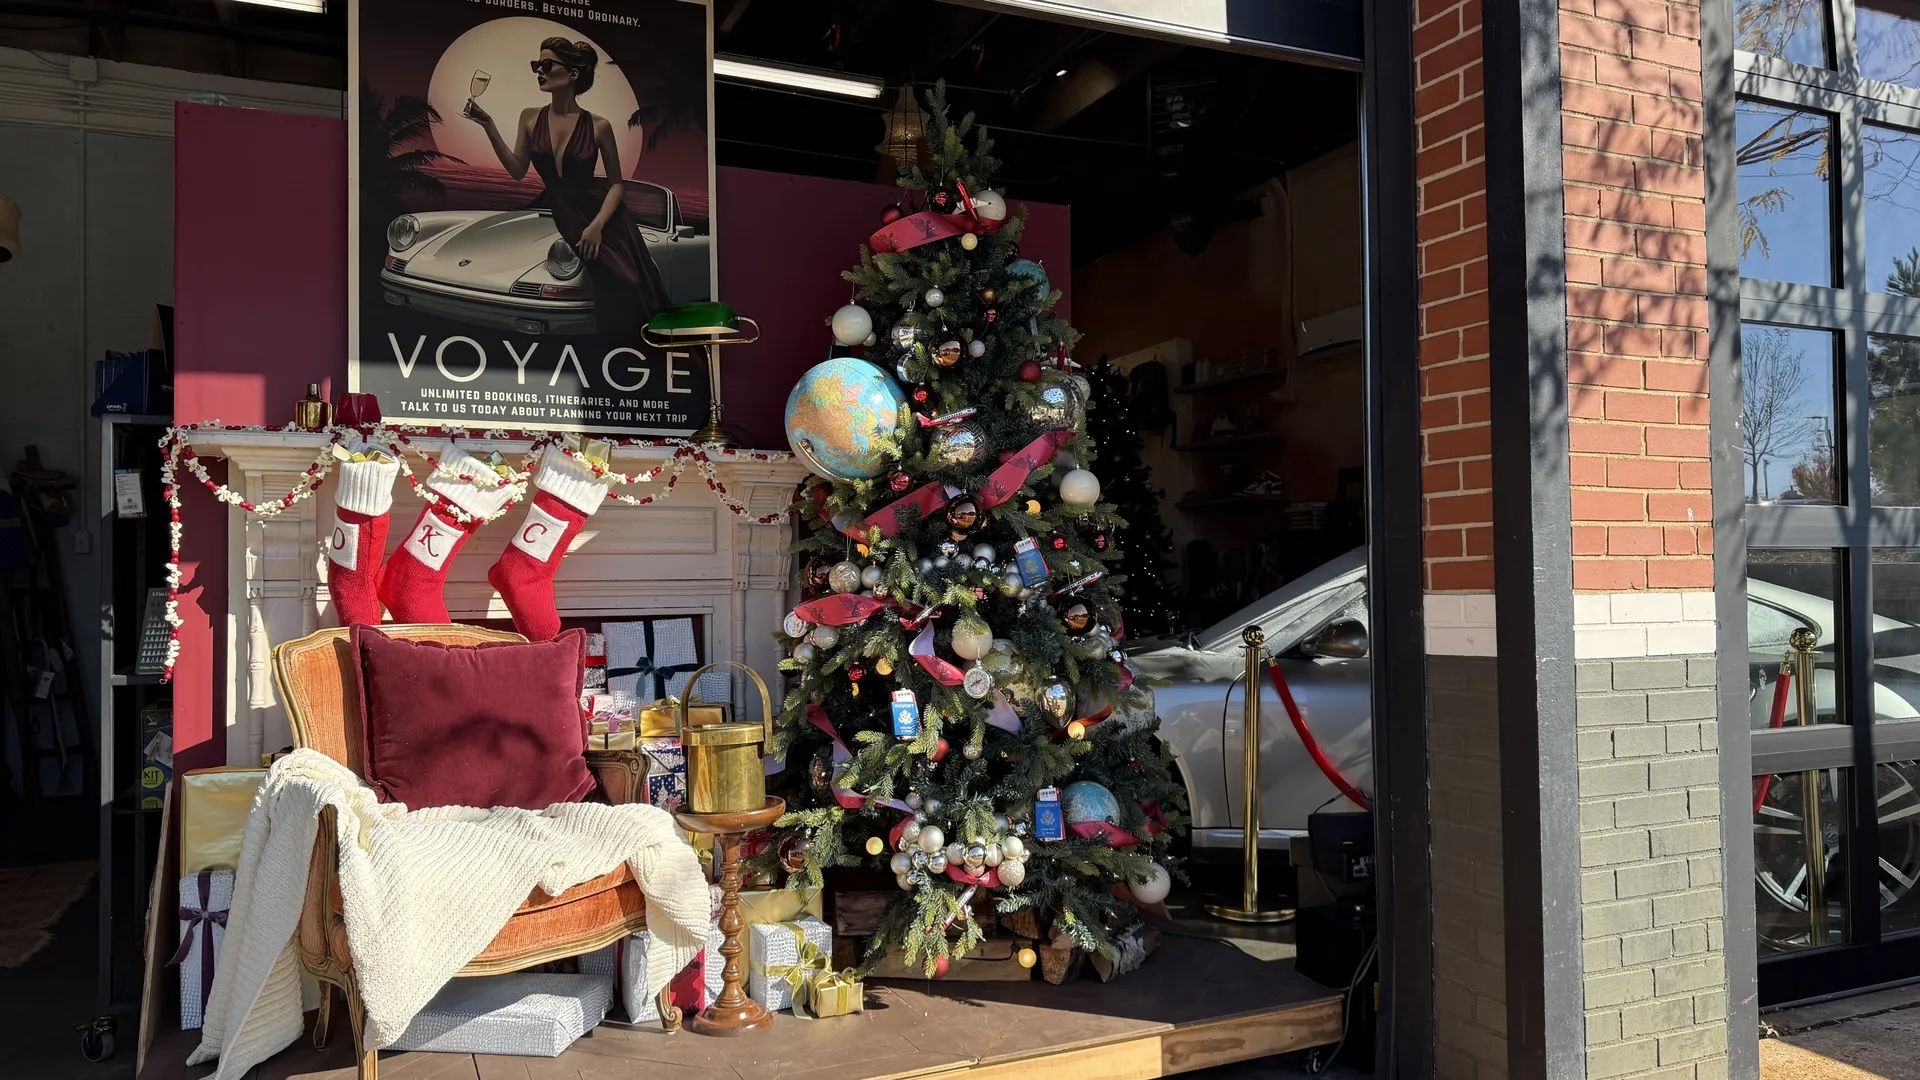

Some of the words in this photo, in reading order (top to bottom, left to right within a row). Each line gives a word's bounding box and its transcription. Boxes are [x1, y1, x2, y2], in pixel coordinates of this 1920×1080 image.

[542, 2, 584, 18] BEYOND
[588, 9, 641, 28] ORDINARY.
[387, 332, 692, 394] VOYAGE
[420, 388, 480, 400] UNLIMITED
[485, 391, 541, 404] BOOKINGS,
[546, 394, 614, 407] ITINERARIES,
[619, 399, 639, 408] AND
[643, 400, 670, 410] MORE
[400, 401, 430, 412] TALK
[434, 403, 448, 412] TO
[453, 404, 467, 413] US
[471, 404, 507, 416] TODAY
[511, 406, 546, 417] ABOUT
[550, 408, 601, 419] PLANNING
[606, 411, 632, 421] YOUR
[636, 413, 661, 422] NEXT
[666, 413, 688, 423] TRIP
[417, 524, 444, 558] K
[522, 522, 548, 544] C
